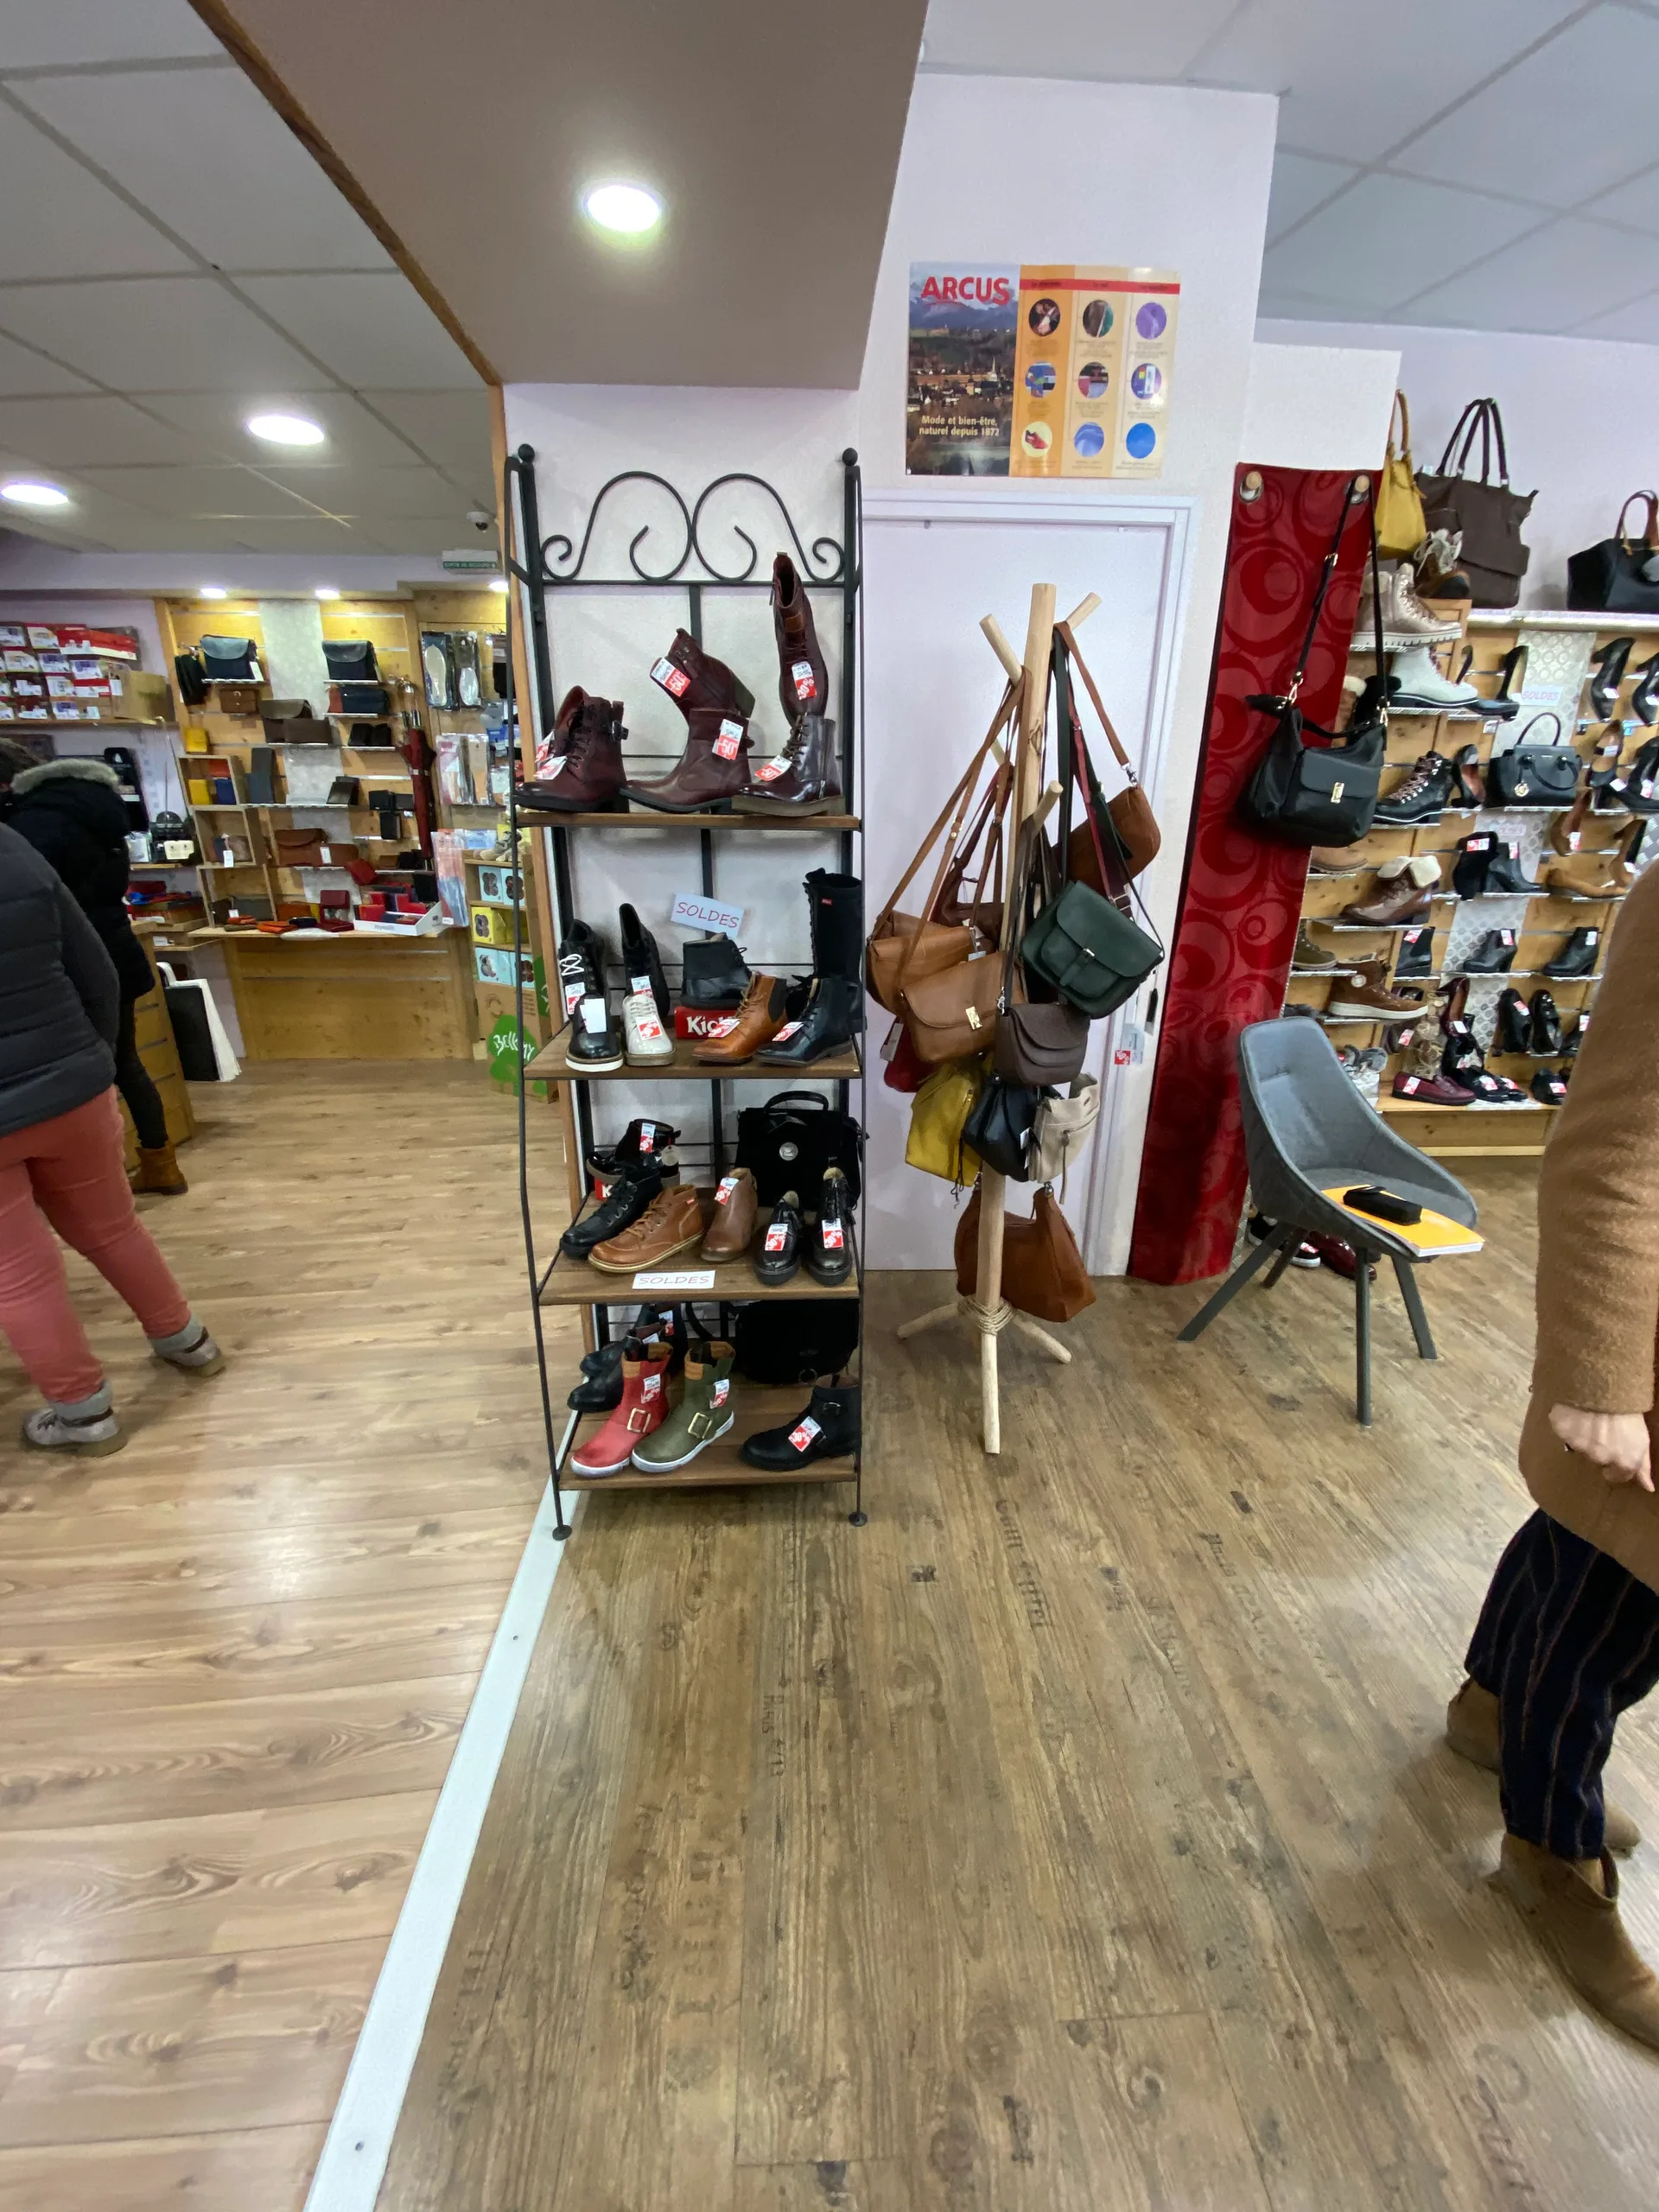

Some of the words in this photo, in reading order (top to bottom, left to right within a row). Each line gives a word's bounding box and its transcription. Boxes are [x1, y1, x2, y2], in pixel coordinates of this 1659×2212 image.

[920, 276, 1010, 305] ARCUS
[921, 415, 945, 424] Mode
[948, 416, 957, 425] et
[958, 416, 998, 427] bien-être,
[918, 426, 949, 435] naturel
[950, 426, 978, 438] depuis
[982, 428, 1000, 436] 1872
[1522, 691, 1560, 701] SOLDES
[677, 902, 740, 928] SOLDES
